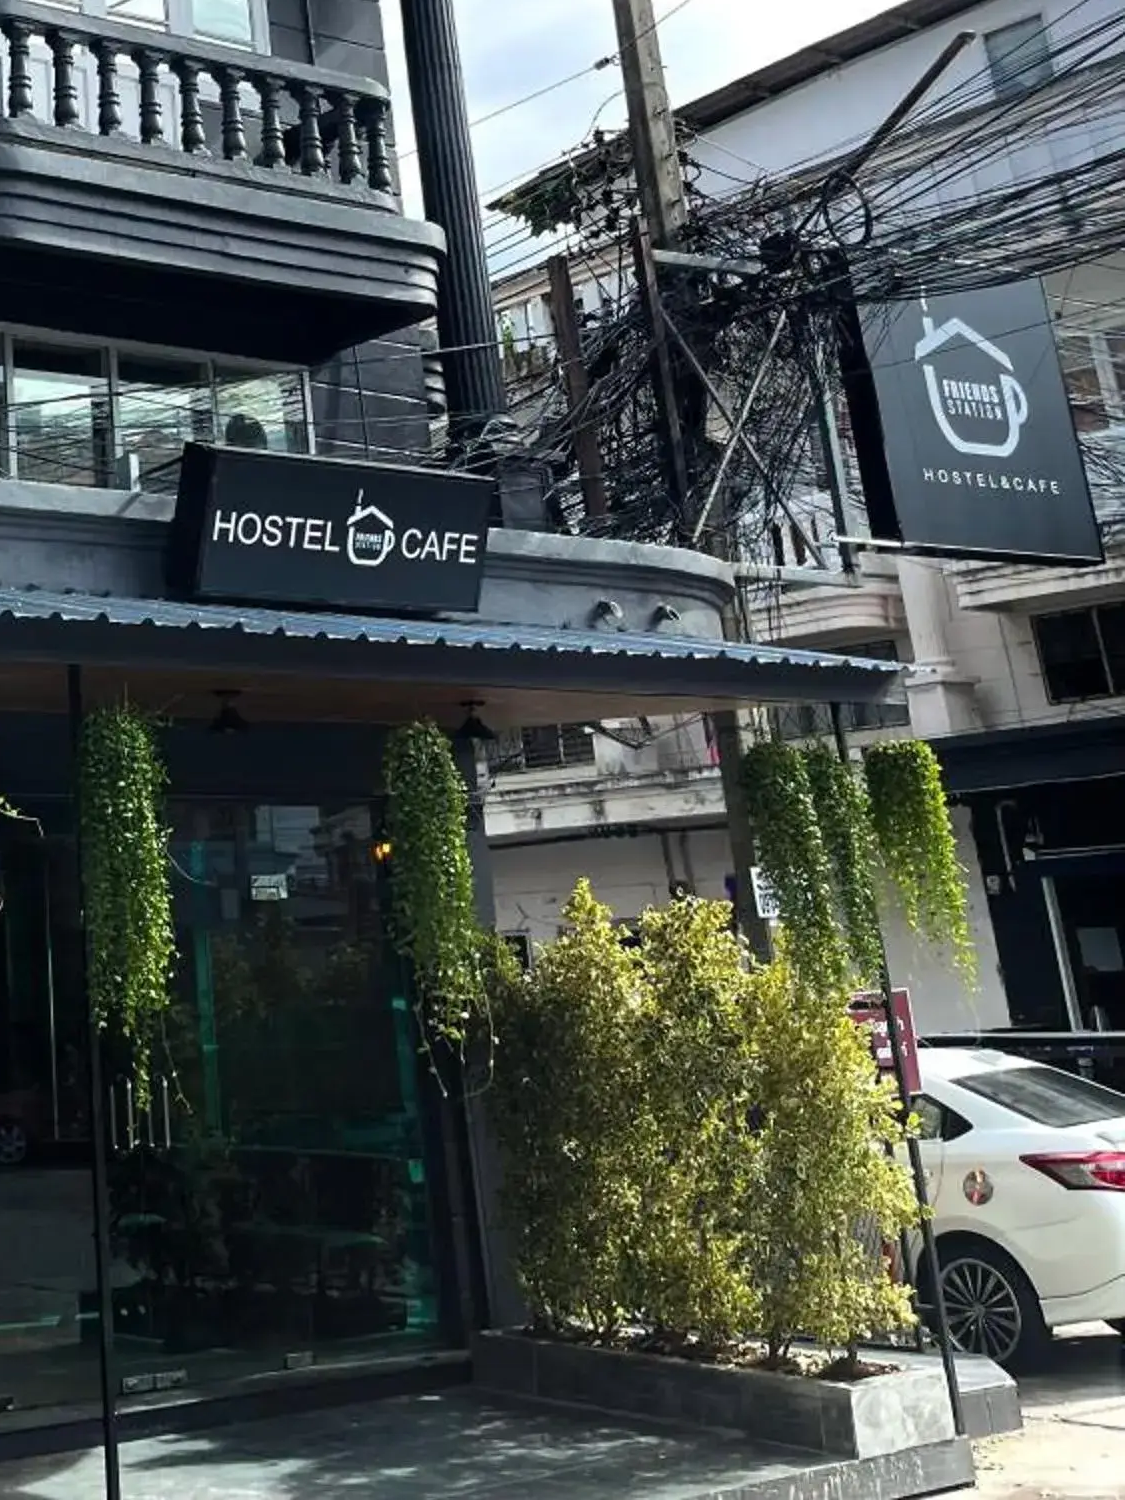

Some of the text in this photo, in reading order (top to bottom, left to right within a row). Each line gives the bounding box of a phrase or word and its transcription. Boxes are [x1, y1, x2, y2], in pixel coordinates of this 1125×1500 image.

[942, 379, 999, 403] FRIENDS
[946, 399, 1003, 420] STATION
[923, 468, 1060, 494] HOSTEL&CAFE
[212, 509, 340, 552] HOSTEL
[401, 528, 479, 563] CAFE
